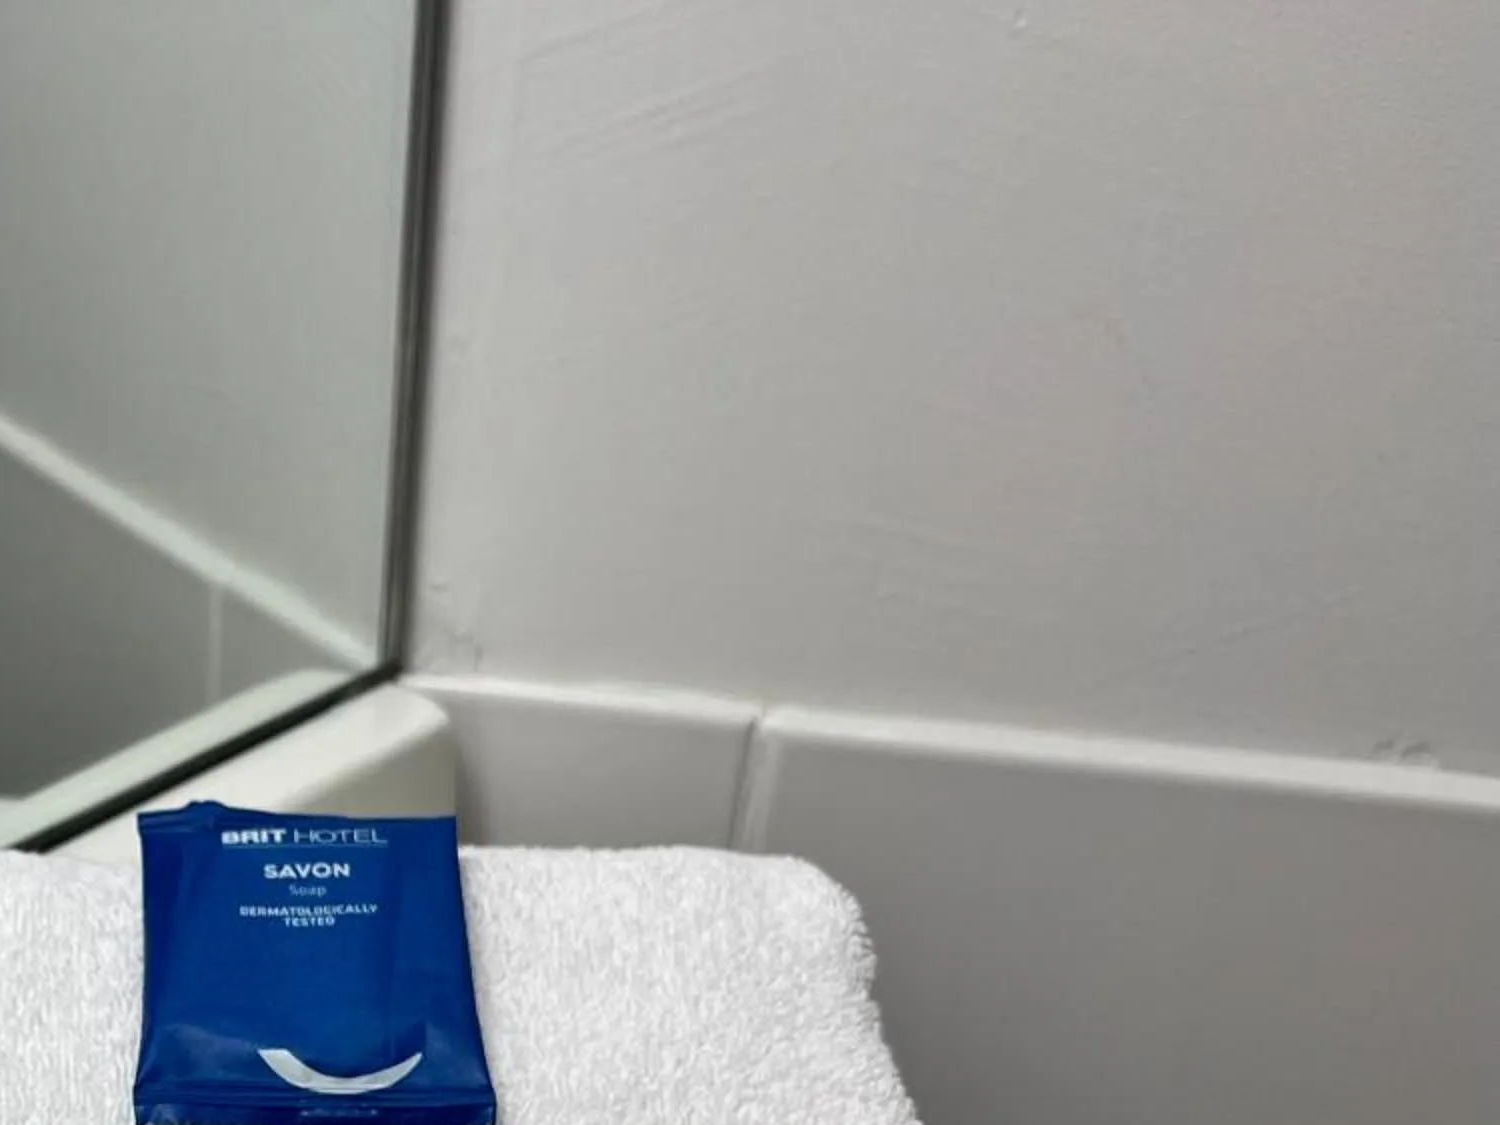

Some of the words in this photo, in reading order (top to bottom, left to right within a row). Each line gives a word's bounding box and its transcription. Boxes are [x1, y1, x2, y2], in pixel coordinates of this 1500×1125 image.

[221, 828, 287, 845] BRIT
[293, 828, 388, 844] HOTEL
[263, 862, 351, 879] SAVON
[288, 883, 328, 897] Soap
[239, 903, 378, 917] DERMATOLOGICALLY
[284, 916, 336, 927] TESTED
